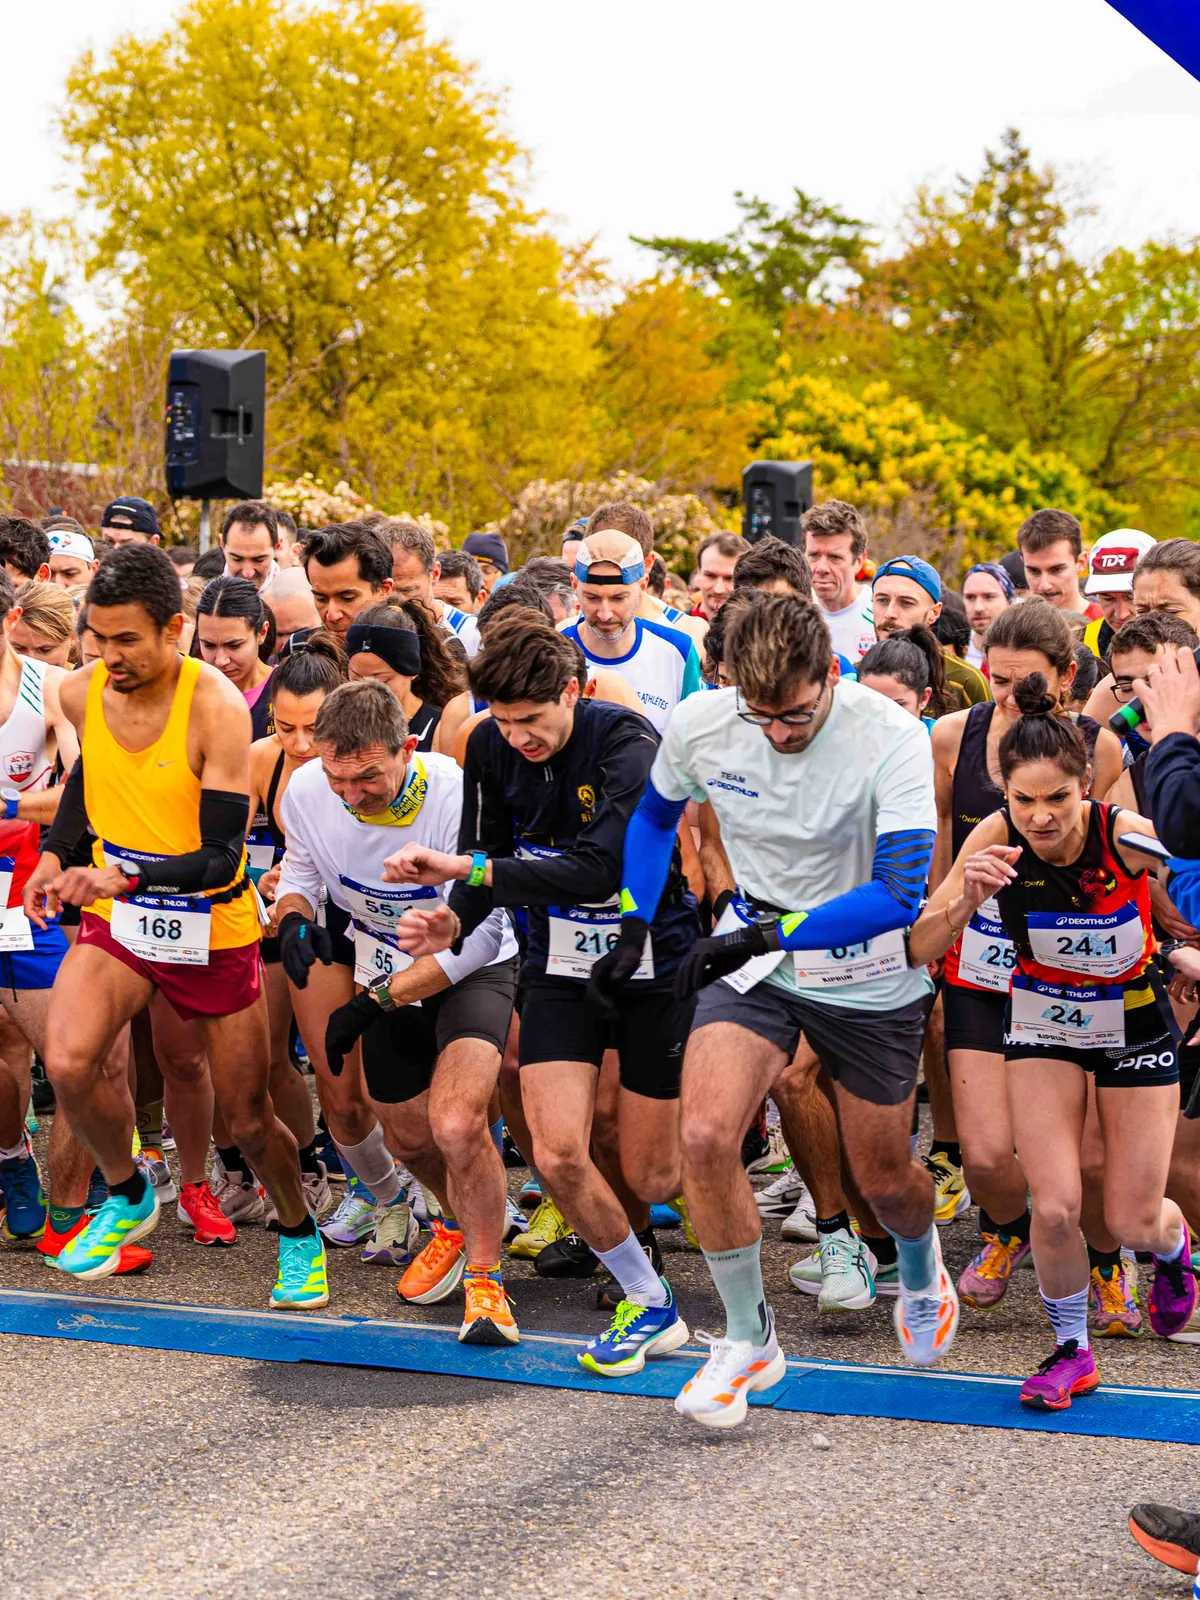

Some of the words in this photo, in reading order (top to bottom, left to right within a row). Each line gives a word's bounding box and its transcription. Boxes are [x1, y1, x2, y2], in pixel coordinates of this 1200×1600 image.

[1102, 554, 1127, 568] TDR
[721, 771, 746, 784] TEAM
[716, 780, 759, 798] DECATHLON
[369, 889, 412, 898] DECATHLON
[138, 915, 182, 940] 168
[1068, 916, 1117, 925] DECATHLON
[1056, 935, 1117, 956] 24.1
[375, 947, 393, 975] 55
[987, 945, 1017, 969] 25
[1050, 1005, 1085, 1028] 24
[1113, 1051, 1175, 1071] PRO
